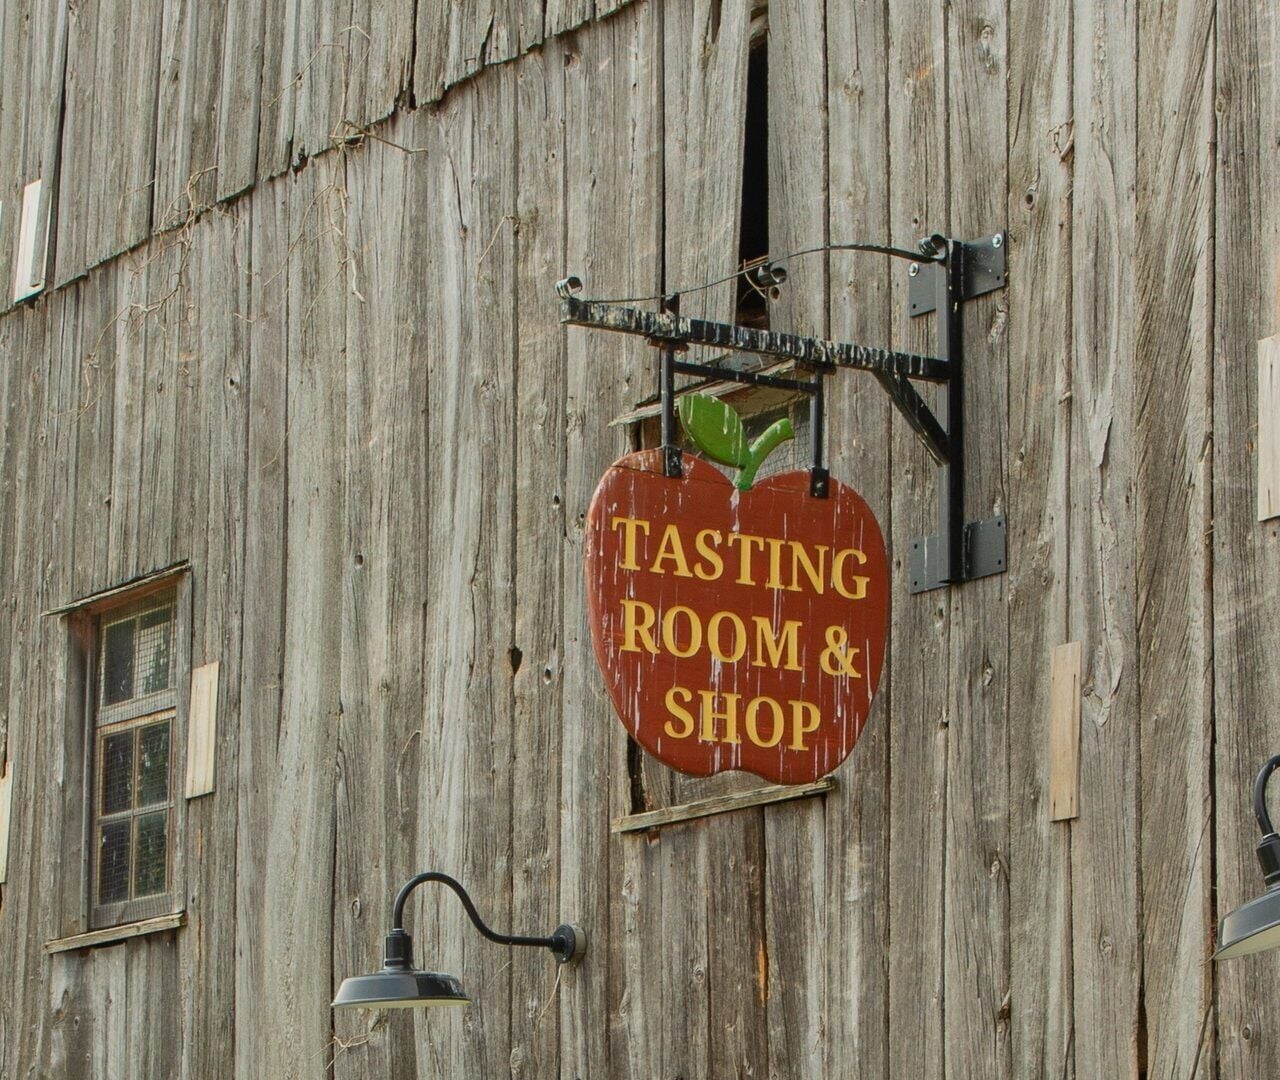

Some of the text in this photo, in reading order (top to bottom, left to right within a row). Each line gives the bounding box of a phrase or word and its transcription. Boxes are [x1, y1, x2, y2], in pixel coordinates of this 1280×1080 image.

[612, 516, 870, 600] TASTING
[620, 599, 861, 678] ROOM &
[664, 686, 821, 751] SHOP
